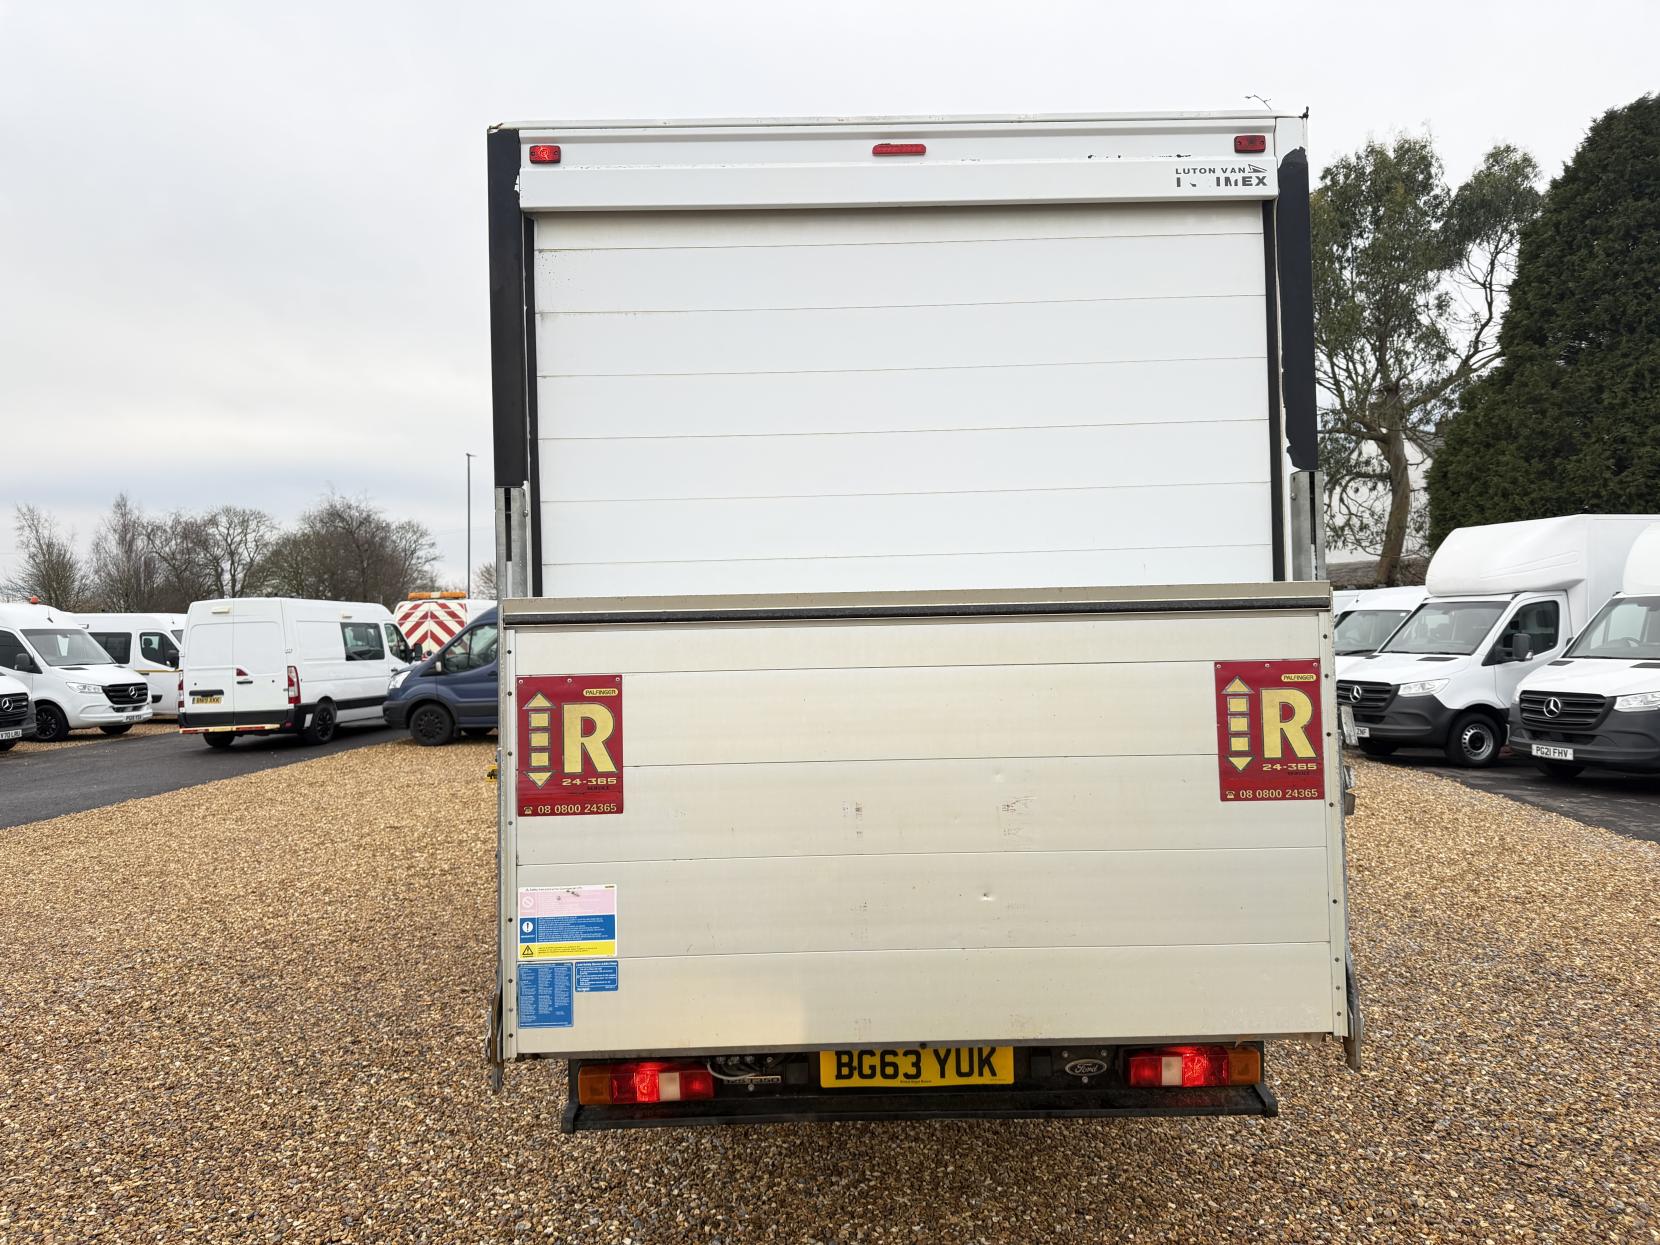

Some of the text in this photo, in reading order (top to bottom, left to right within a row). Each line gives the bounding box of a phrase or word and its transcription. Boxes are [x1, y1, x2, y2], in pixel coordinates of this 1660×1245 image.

[1176, 176, 1268, 187] IIMEX
[1260, 687, 1318, 759] R
[562, 702, 618, 774] R
[1536, 746, 1568, 758] PG21 FHV
[1262, 763, 1317, 771] 24-365
[1240, 789, 1318, 798] 08 0800 24365
[537, 803, 617, 814] 08 0800 24365
[835, 1047, 998, 1080] BG63 YUK
[1075, 1062, 1099, 1074] Ford
